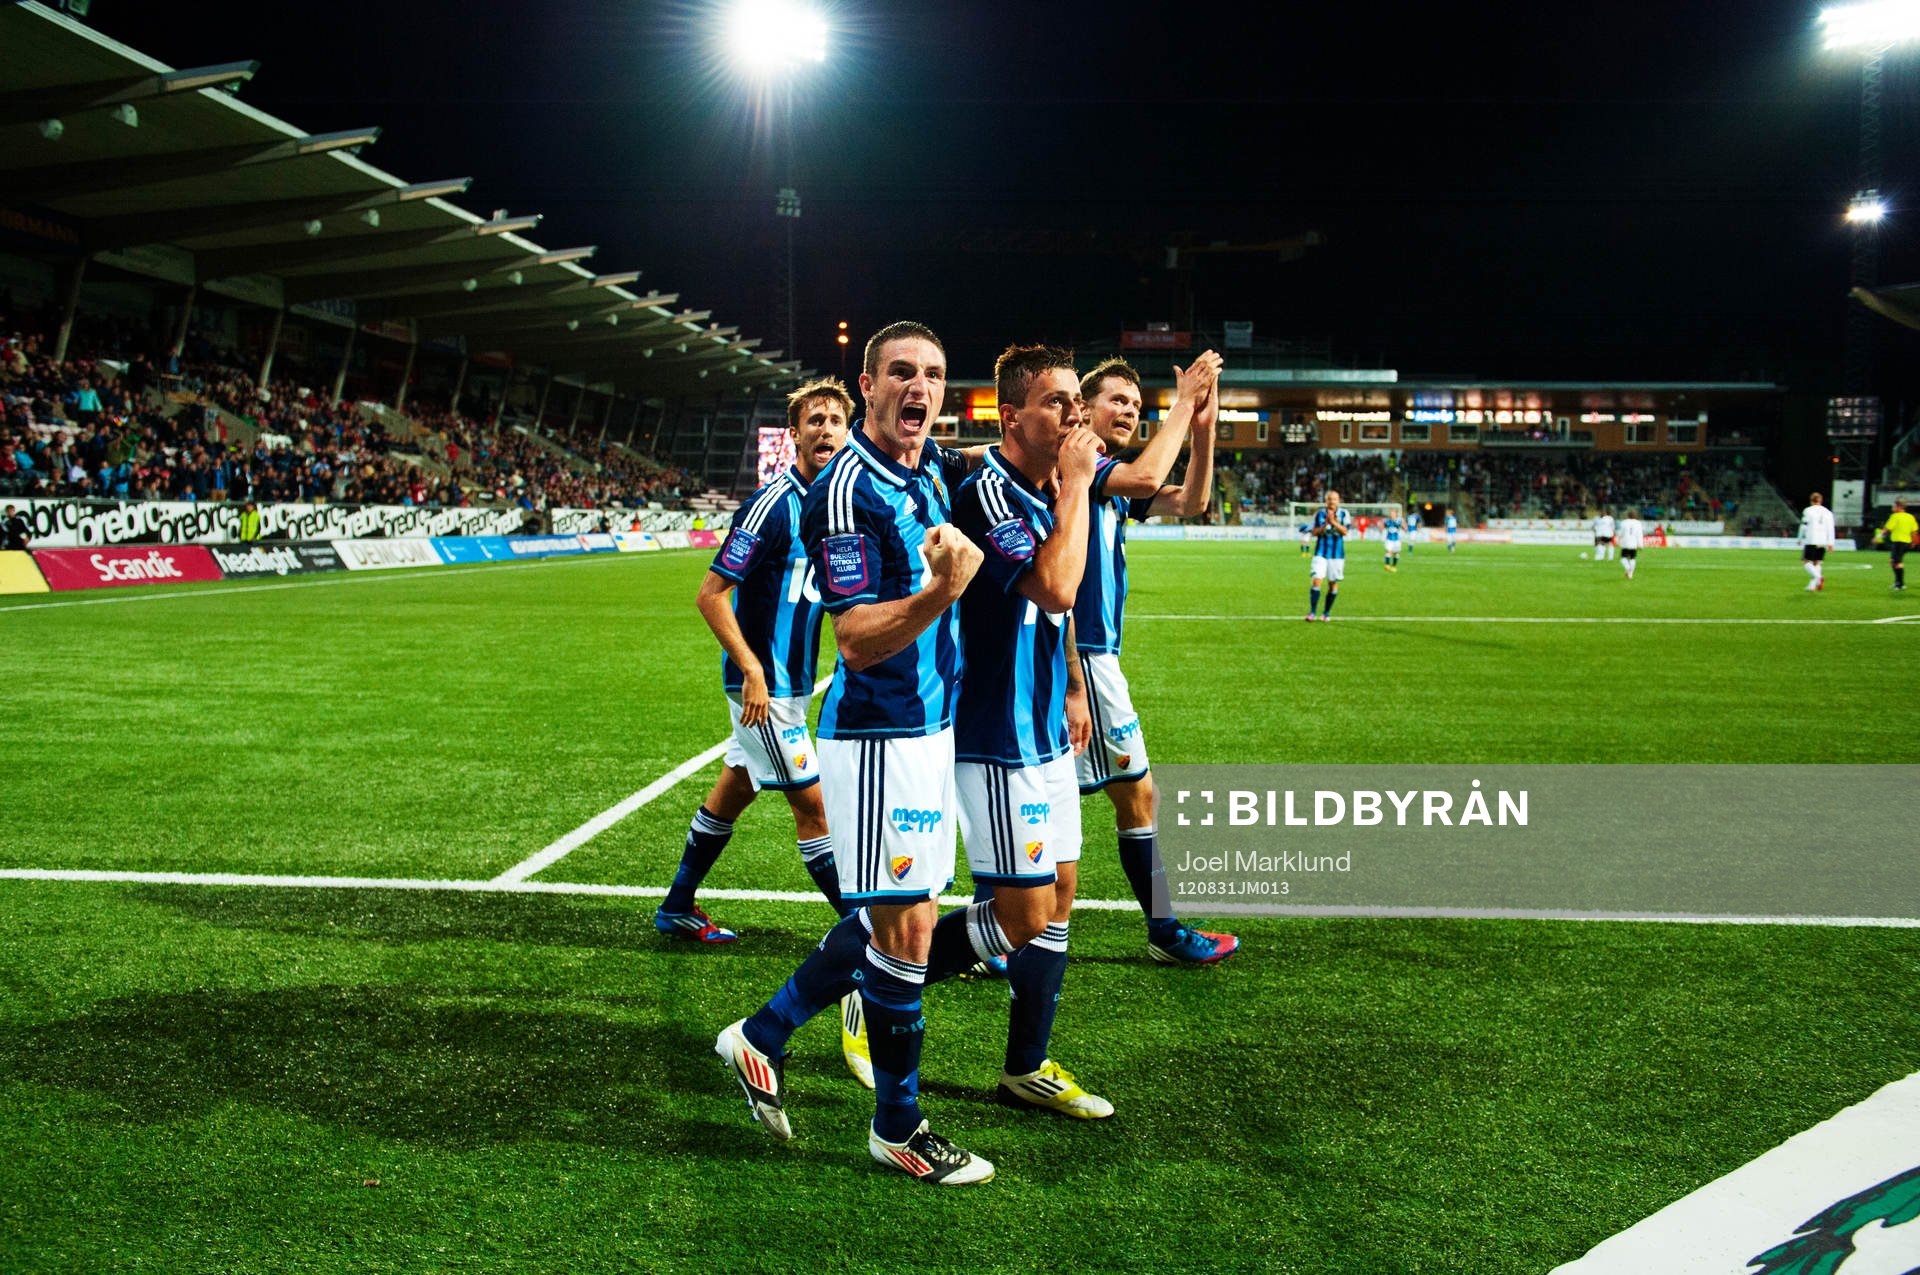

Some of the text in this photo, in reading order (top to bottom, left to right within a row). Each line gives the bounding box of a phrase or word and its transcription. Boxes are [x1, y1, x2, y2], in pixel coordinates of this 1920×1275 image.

[228, 503, 289, 543] öbro
[90, 550, 183, 581] Scandic
[212, 547, 303, 576] headlight
[830, 551, 861, 561] SVERIGES
[830, 558, 862, 567] FOTBOLLS
[836, 564, 857, 573] KLUBB
[892, 808, 942, 833] mopp
